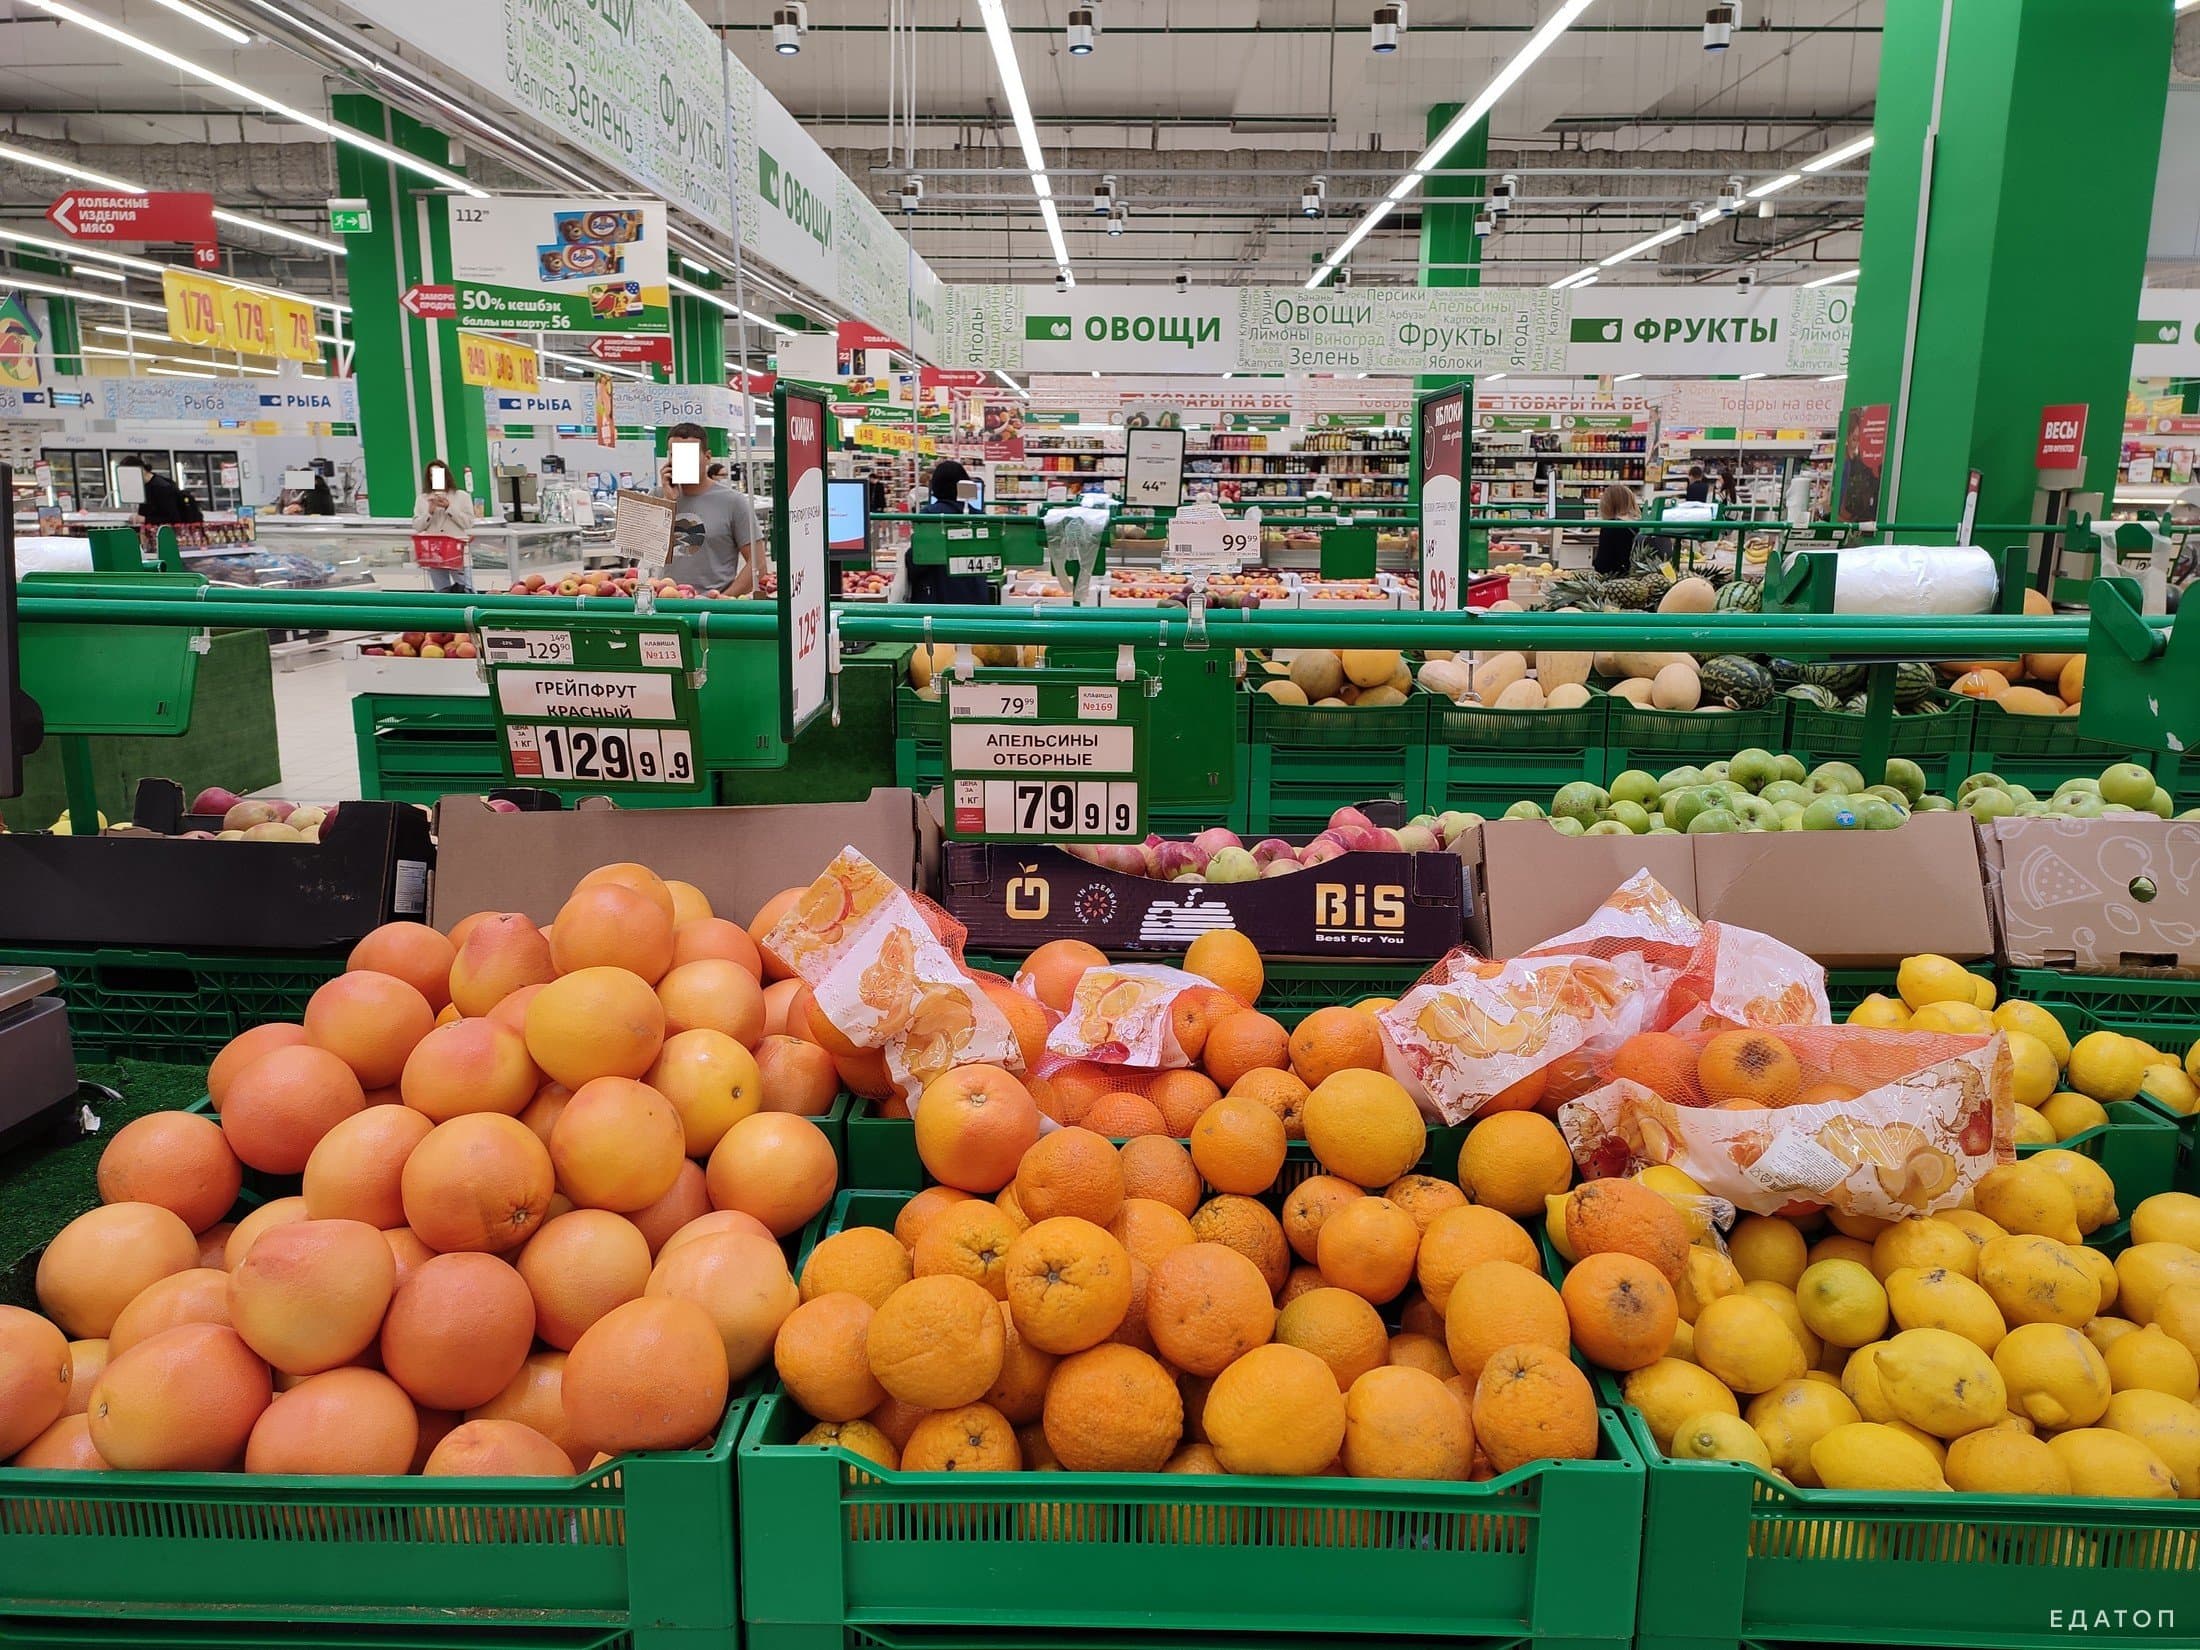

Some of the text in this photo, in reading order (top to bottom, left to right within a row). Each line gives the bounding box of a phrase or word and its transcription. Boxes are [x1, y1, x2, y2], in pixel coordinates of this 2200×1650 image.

[588, 34, 651, 115] Виноград
[515, 62, 561, 114] Капуста
[566, 61, 633, 154] Зелень
[659, 69, 726, 173] Фрукты
[684, 168, 718, 215] Яблоки
[77, 197, 150, 209] КОЛБАСНЫЕ
[79, 210, 137, 222] ИЗДЕЛИЯ
[455, 209, 483, 222] 112
[784, 170, 833, 257] ОВОЩИ
[81, 222, 115, 234] МЯСО
[197, 249, 216, 262] 16
[462, 289, 507, 311] 50%
[507, 300, 561, 312] кешбэк
[1297, 293, 1334, 302] Бананы
[1366, 289, 1426, 302] Персики
[180, 289, 216, 334] 179
[1239, 288, 1248, 336] Клубника
[1259, 290, 1273, 329] Груши
[1274, 299, 1372, 328] Овощи
[1389, 310, 1425, 320] Арбузы
[1428, 300, 1512, 313] Апельсины
[1548, 288, 1561, 336] Капуста
[1811, 289, 1828, 330] Груши
[233, 301, 265, 343] 179
[462, 315, 571, 331] баллы на карту: 56
[988, 286, 1002, 369] Мандарины
[1442, 315, 1497, 325] Картофель
[969, 307, 984, 363] Ягоды
[1084, 316, 1221, 349] ОВОЩИ
[1248, 328, 1310, 341] Лимоны
[1399, 321, 1502, 353] Фрукты
[1511, 310, 1529, 366] Ягоды
[1531, 287, 1548, 372] Мандарины
[1633, 317, 1778, 343] ФРУКТЫ
[1314, 332, 1386, 347] Виноград
[1245, 358, 1284, 369] Капуста
[1289, 347, 1360, 366] Зелень
[1429, 355, 1483, 369] Яблоки
[184, 394, 225, 411] Рыба
[286, 394, 332, 409] РЫБА
[527, 398, 571, 411] РЫБА
[662, 400, 703, 416] Рыба
[1150, 393, 1293, 408] ТОВАРЫ НА ВЕС
[1509, 396, 1655, 411] ТОВАРЫ НА ВЕС
[1720, 396, 1833, 412] Товары на вес
[790, 416, 815, 446] СКИДКА
[2045, 420, 2079, 440] ВЕСЫ
[1142, 481, 1160, 492] 44
[1222, 534, 1247, 551] 99
[967, 559, 984, 572] 44
[1430, 568, 1447, 611] 99
[550, 634, 566, 642] 149
[798, 608, 817, 659] 129
[527, 643, 570, 659] 129 90
[645, 650, 677, 660] №113
[535, 678, 637, 698] ГРЕЙПФРУТ
[547, 704, 633, 719] КРАСНЫЙ
[1000, 697, 1025, 714] 79
[1083, 702, 1113, 712] №169
[514, 740, 532, 748] 1 КГ
[986, 734, 1099, 748] АПЕЛЬСИНЫ
[545, 730, 630, 779] 129
[993, 753, 1093, 766] ОТБОРНЫЕ
[1018, 785, 1074, 829] 79
[1074, 883, 1118, 925] MADE IN AZERBAIJAN
[1315, 934, 1404, 944] Best For You
